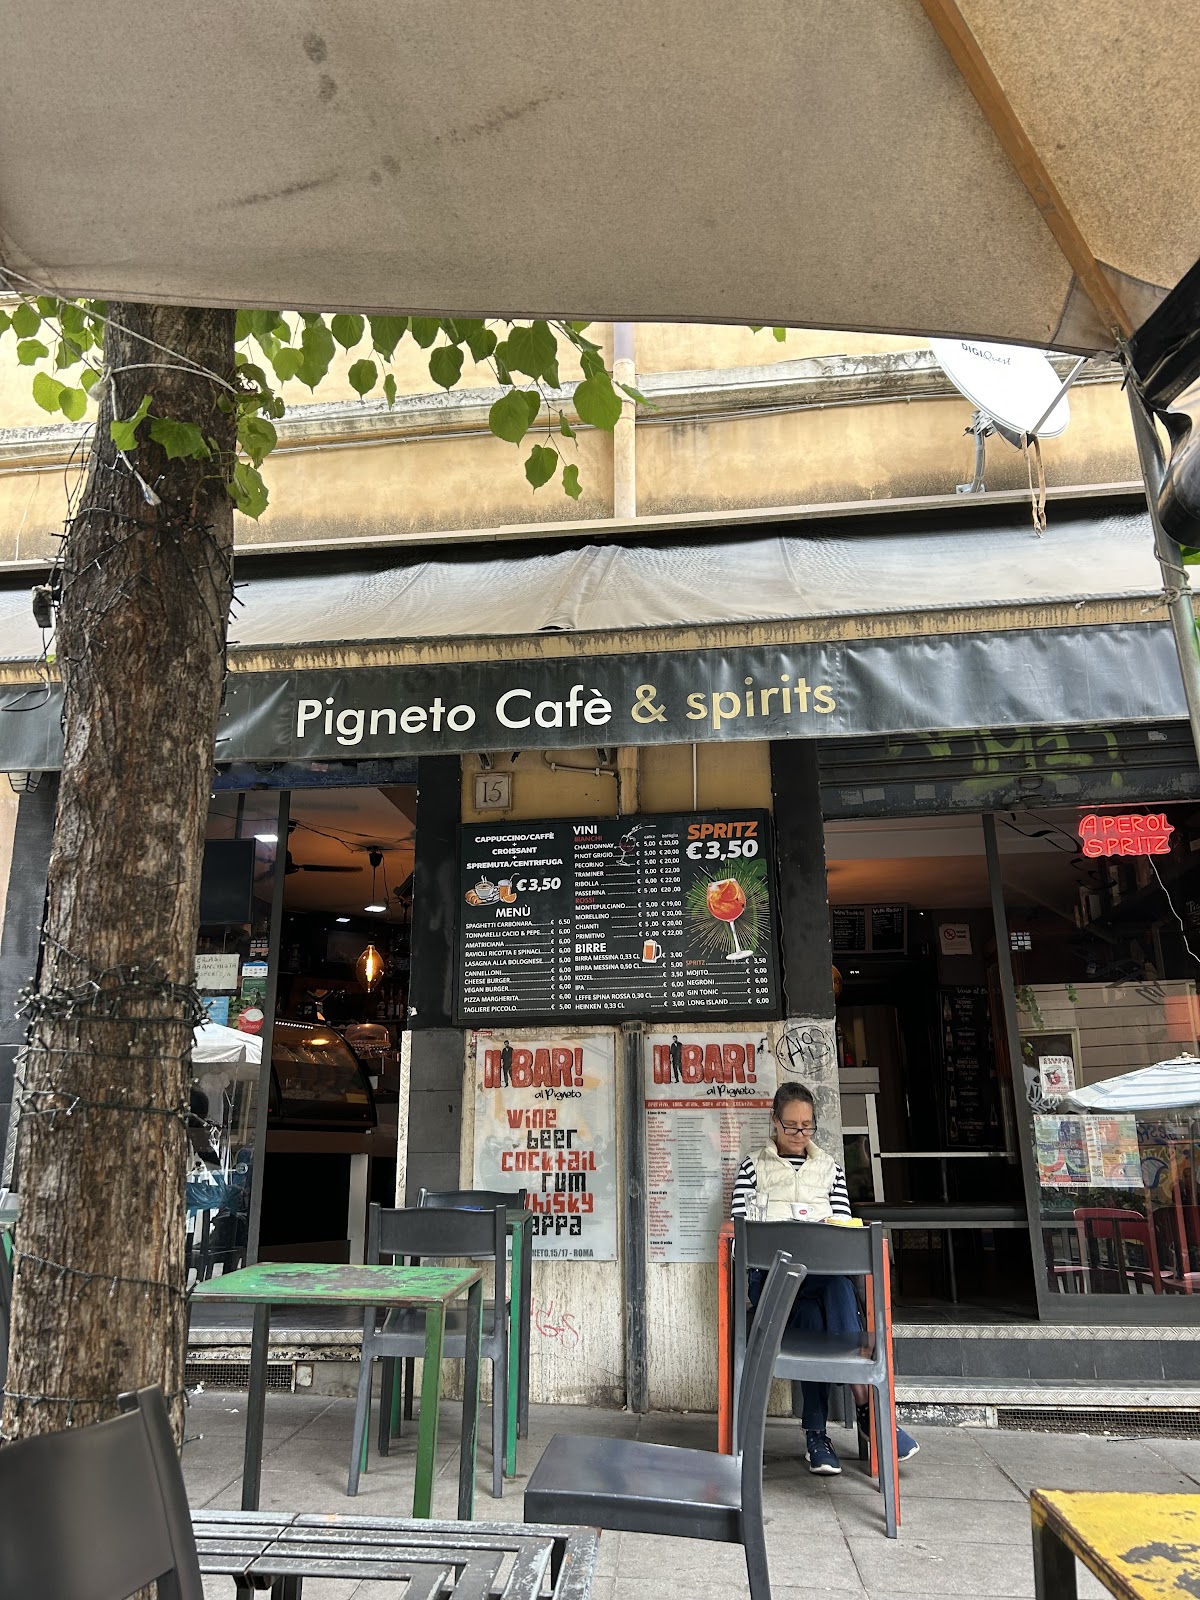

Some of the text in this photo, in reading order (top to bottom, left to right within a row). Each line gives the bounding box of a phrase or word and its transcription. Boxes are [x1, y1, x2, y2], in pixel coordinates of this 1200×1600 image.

[296, 674, 836, 745] Pigneto Cafè & spirits
[482, 780, 503, 803] 15
[573, 825, 598, 835] VINI
[687, 821, 758, 840] SPRITZ
[1082, 815, 1173, 835] APEROL
[492, 847, 537, 855] CROISSANT
[705, 839, 758, 860] 3,50
[1086, 836, 1169, 855] SPRITZ
[466, 859, 563, 869] SPREMUTA/CENTRIFUGA
[528, 877, 561, 892] 3,50
[496, 904, 530, 917] MENÙ
[575, 943, 606, 953] BIRRE
[512, 1048, 583, 1088] BAR!
[682, 1044, 757, 1084] BAR!
[535, 1088, 581, 1100] al Pigneto
[707, 1085, 755, 1097] al Pigneto
[574, 1249, 593, 1257] ROMA
